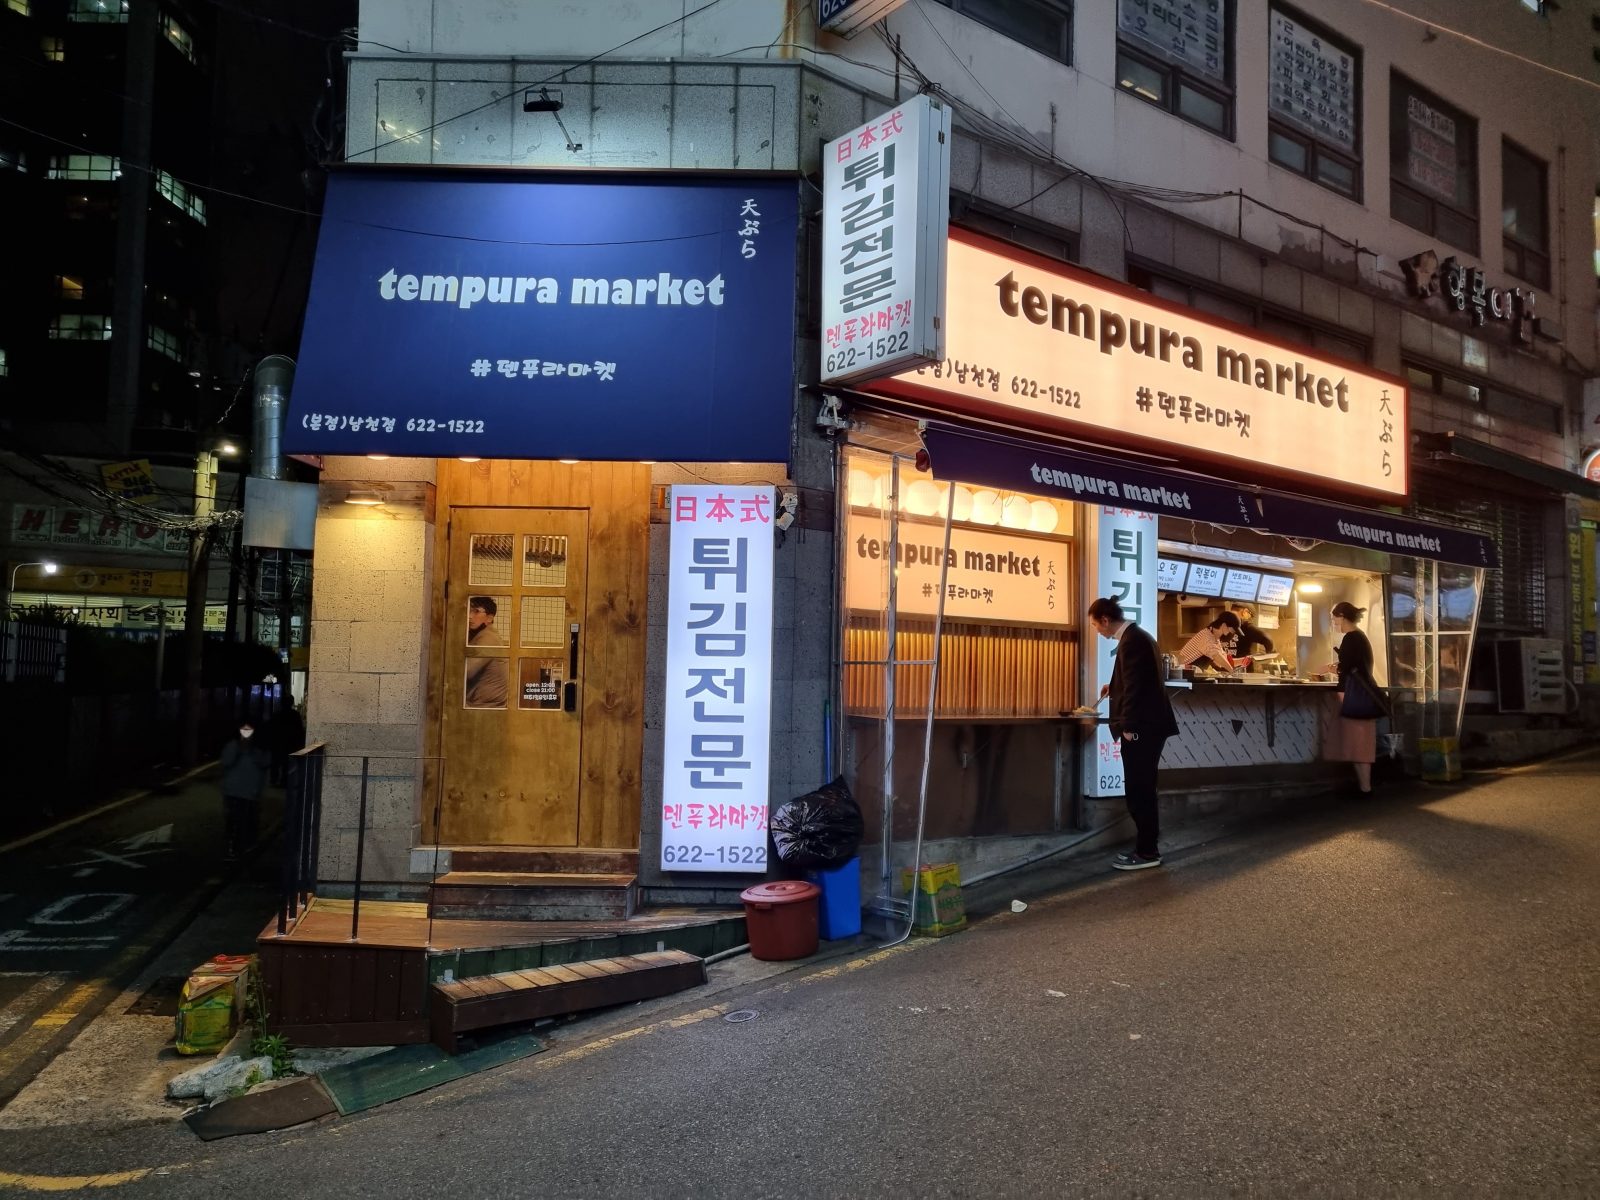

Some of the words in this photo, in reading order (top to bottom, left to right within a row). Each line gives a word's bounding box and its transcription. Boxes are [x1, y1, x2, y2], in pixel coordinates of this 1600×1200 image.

[836, 110, 904, 163] 日本式
[737, 198, 762, 260] 天ぶら
[838, 142, 897, 314] 튀김전문
[377, 267, 559, 310] tempura
[570, 272, 725, 307] market
[826, 330, 909, 373] 622-1522
[994, 270, 1204, 373] tempura
[1216, 343, 1350, 413] market
[1011, 375, 1081, 410] 622-1522
[406, 417, 486, 435] 622-1522
[1378, 388, 1394, 478] 天ぶら
[1030, 462, 1120, 494] tempura
[1122, 481, 1192, 510] market
[675, 492, 771, 524] 日本式
[1337, 518, 1394, 545] tempura
[1396, 532, 1441, 553] market
[964, 550, 1041, 577] market
[683, 536, 752, 790] 튀김전문
[663, 844, 768, 865] 622-1522
